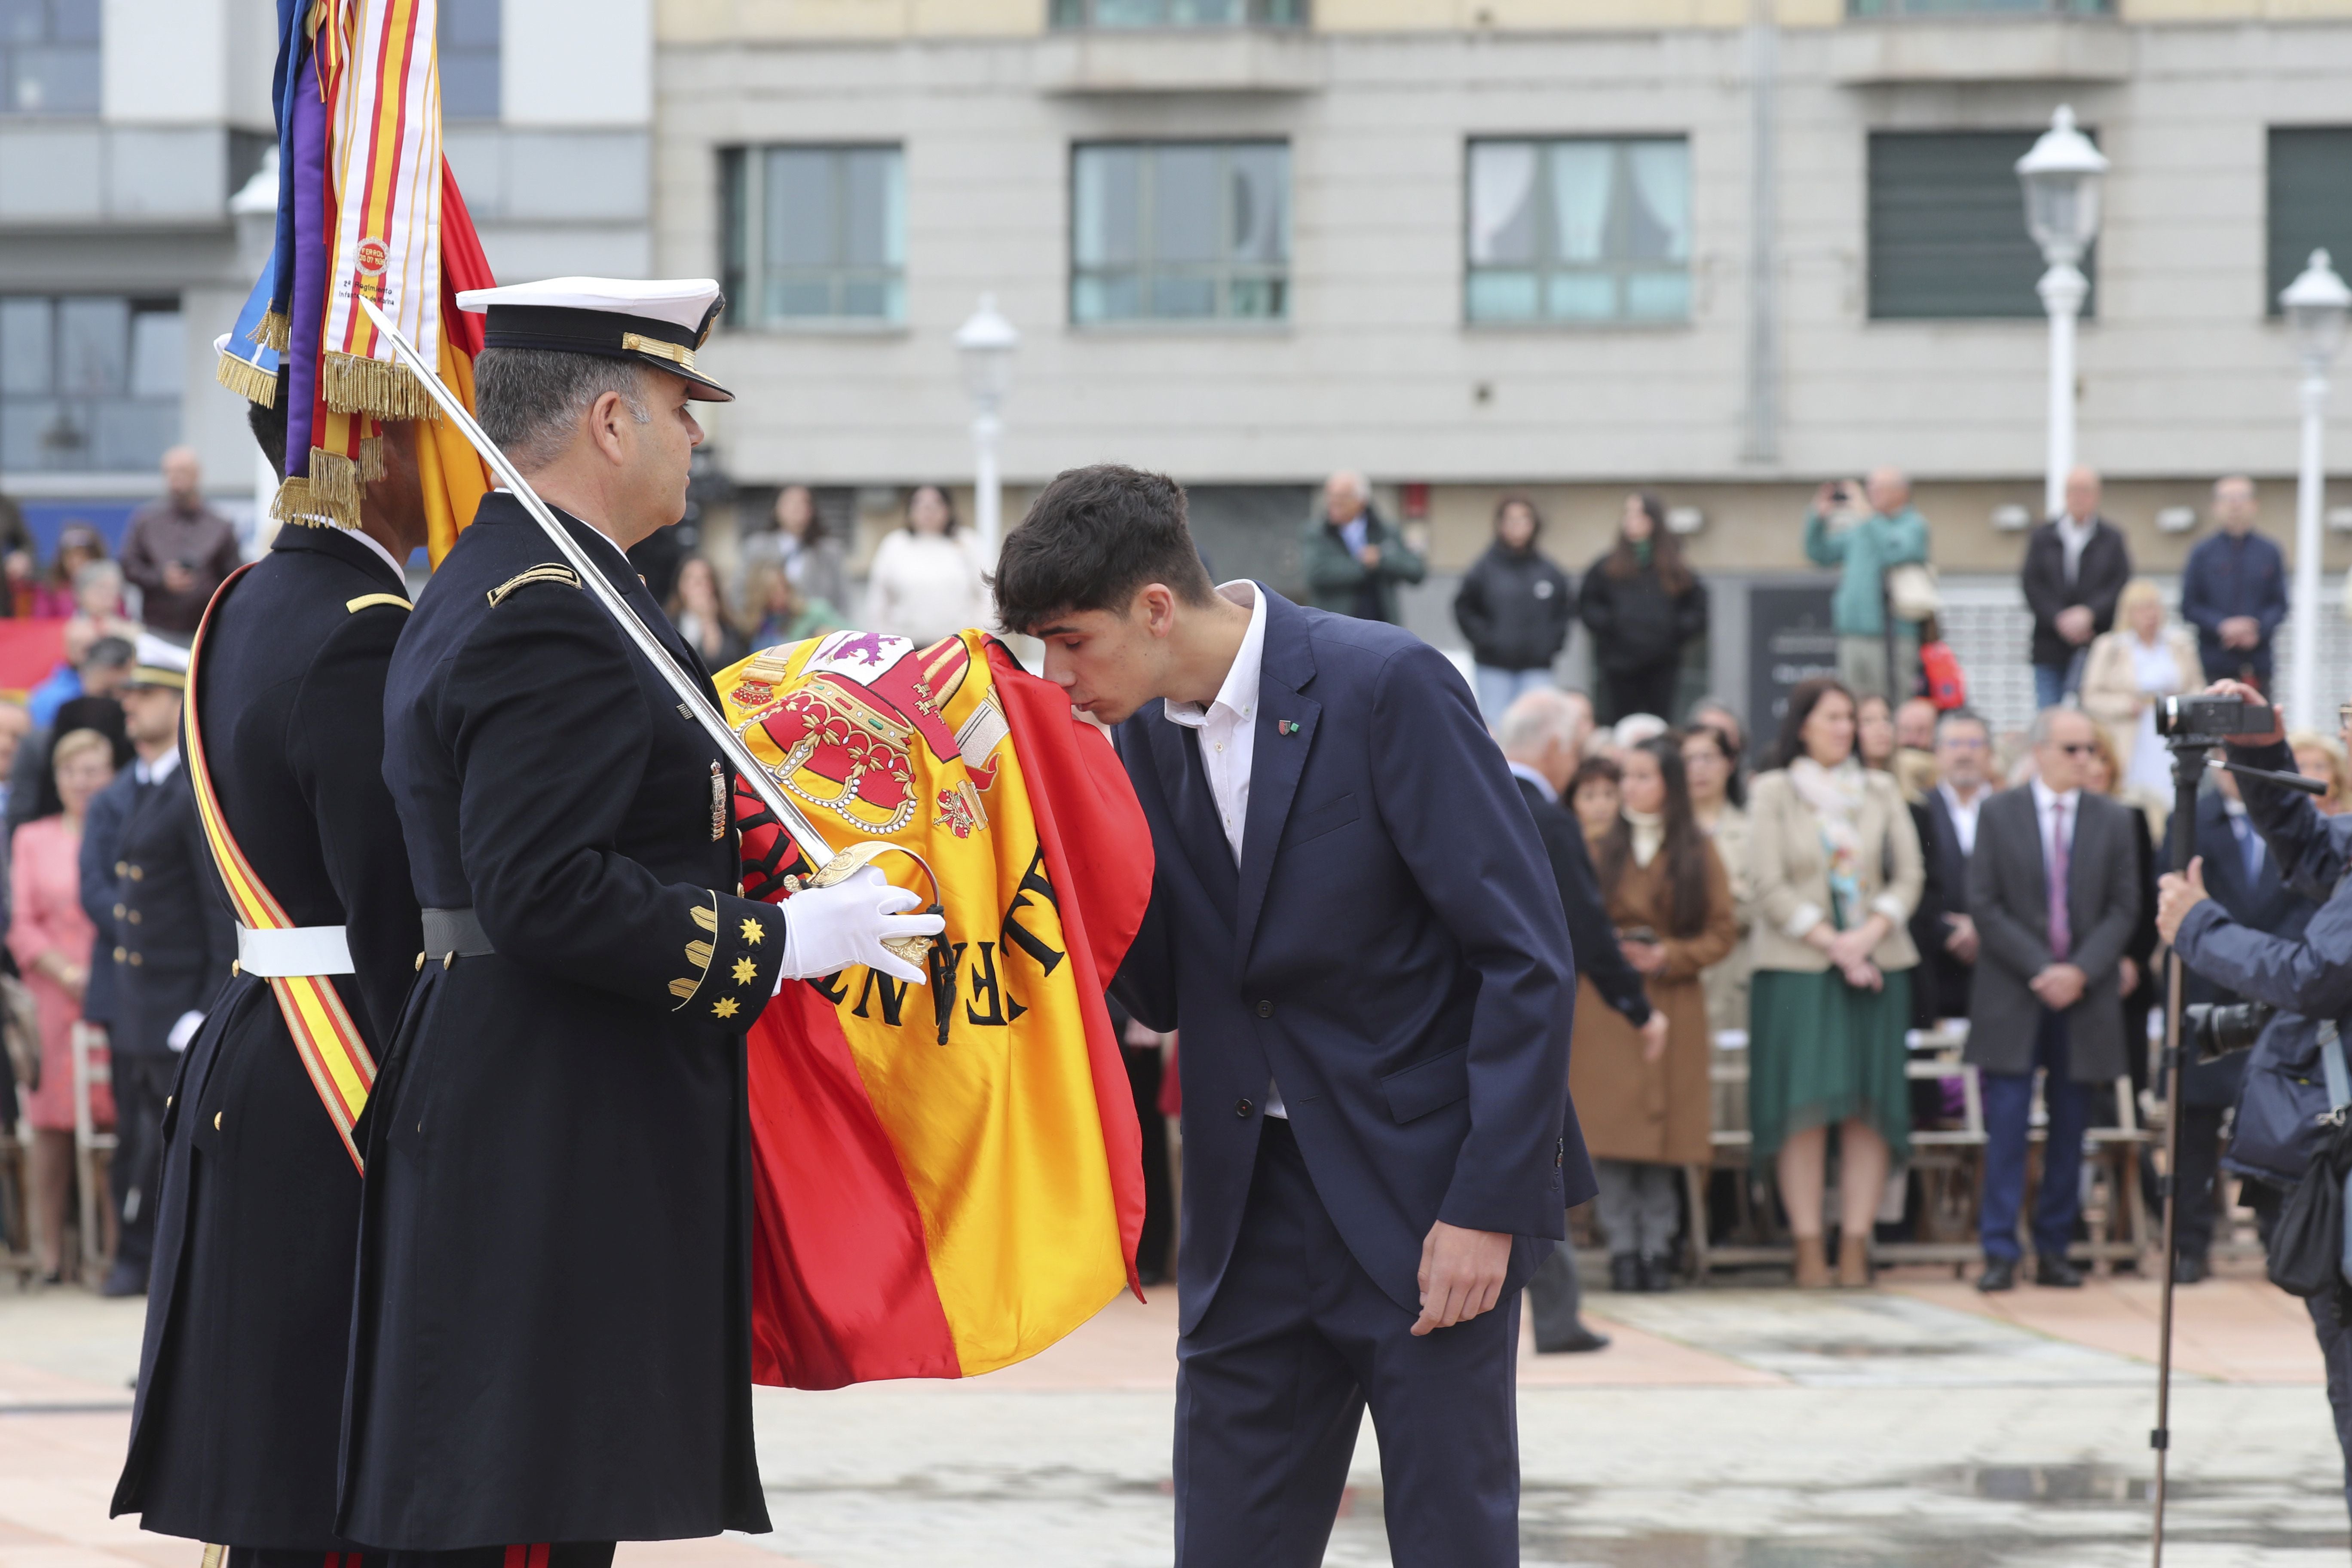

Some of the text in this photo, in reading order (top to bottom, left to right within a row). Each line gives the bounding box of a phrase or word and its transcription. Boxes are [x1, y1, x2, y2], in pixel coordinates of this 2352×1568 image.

[361, 248, 384, 258] FERROL
[354, 281, 392, 294] Regimiento
[377, 297, 394, 305] Marina
